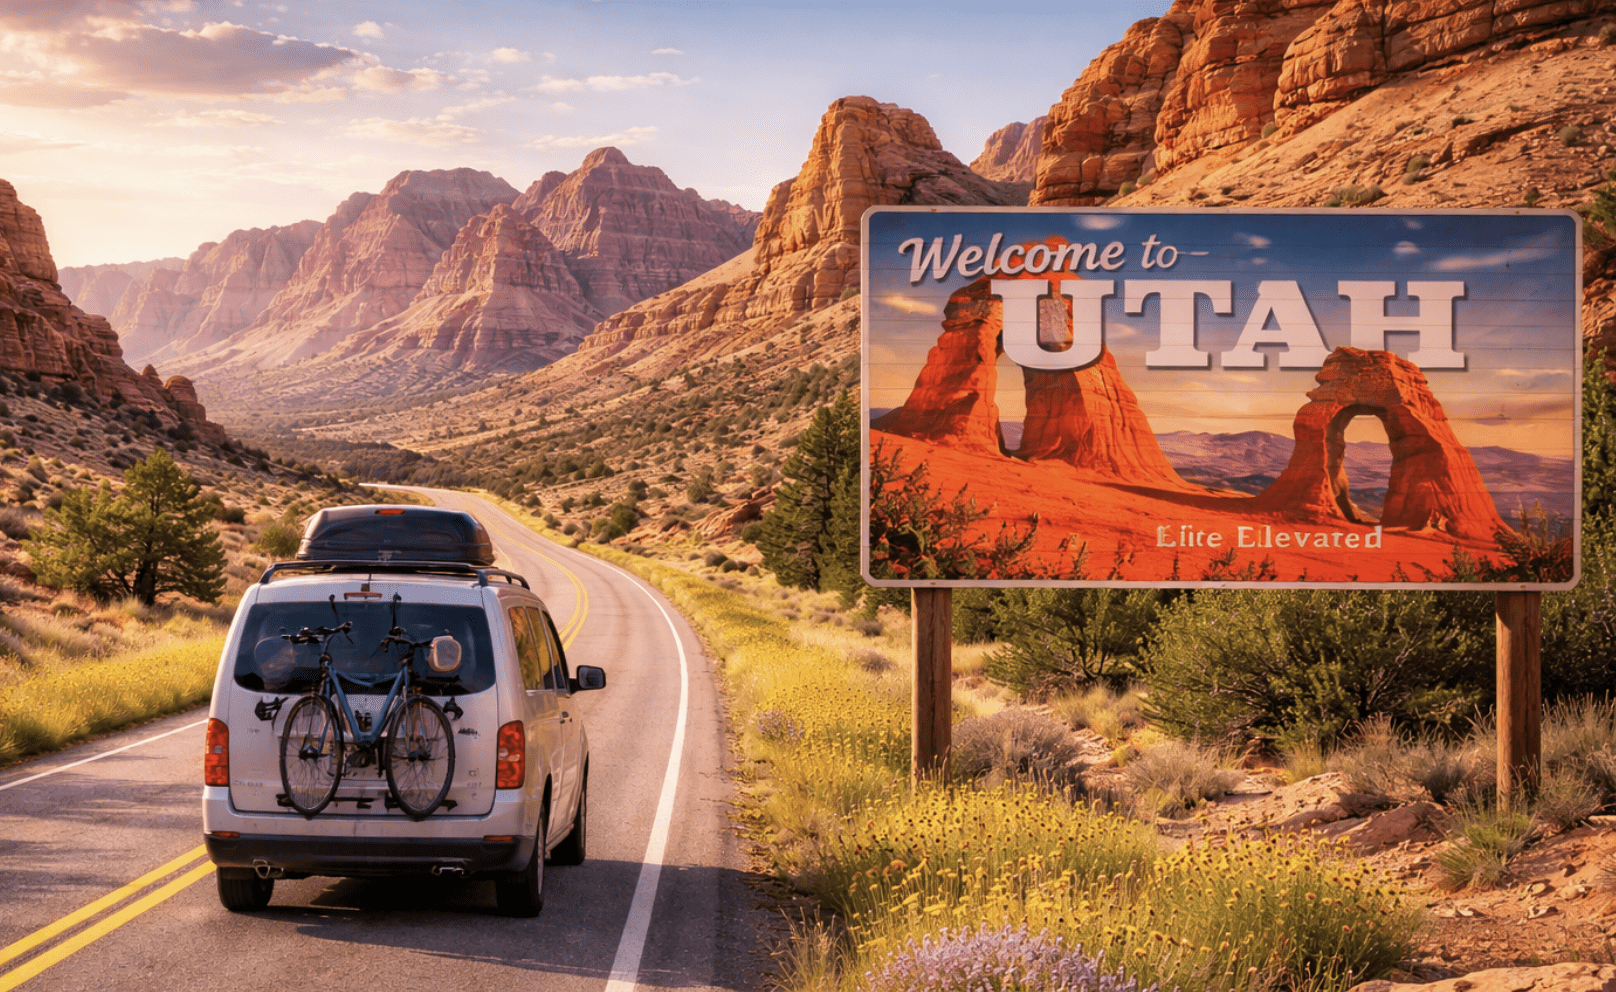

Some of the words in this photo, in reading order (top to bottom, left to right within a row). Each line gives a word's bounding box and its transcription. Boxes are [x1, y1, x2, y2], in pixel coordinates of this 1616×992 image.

[898, 232, 1126, 283] Welcome
[1141, 234, 1182, 270] to
[990, 278, 1466, 370] UTAH
